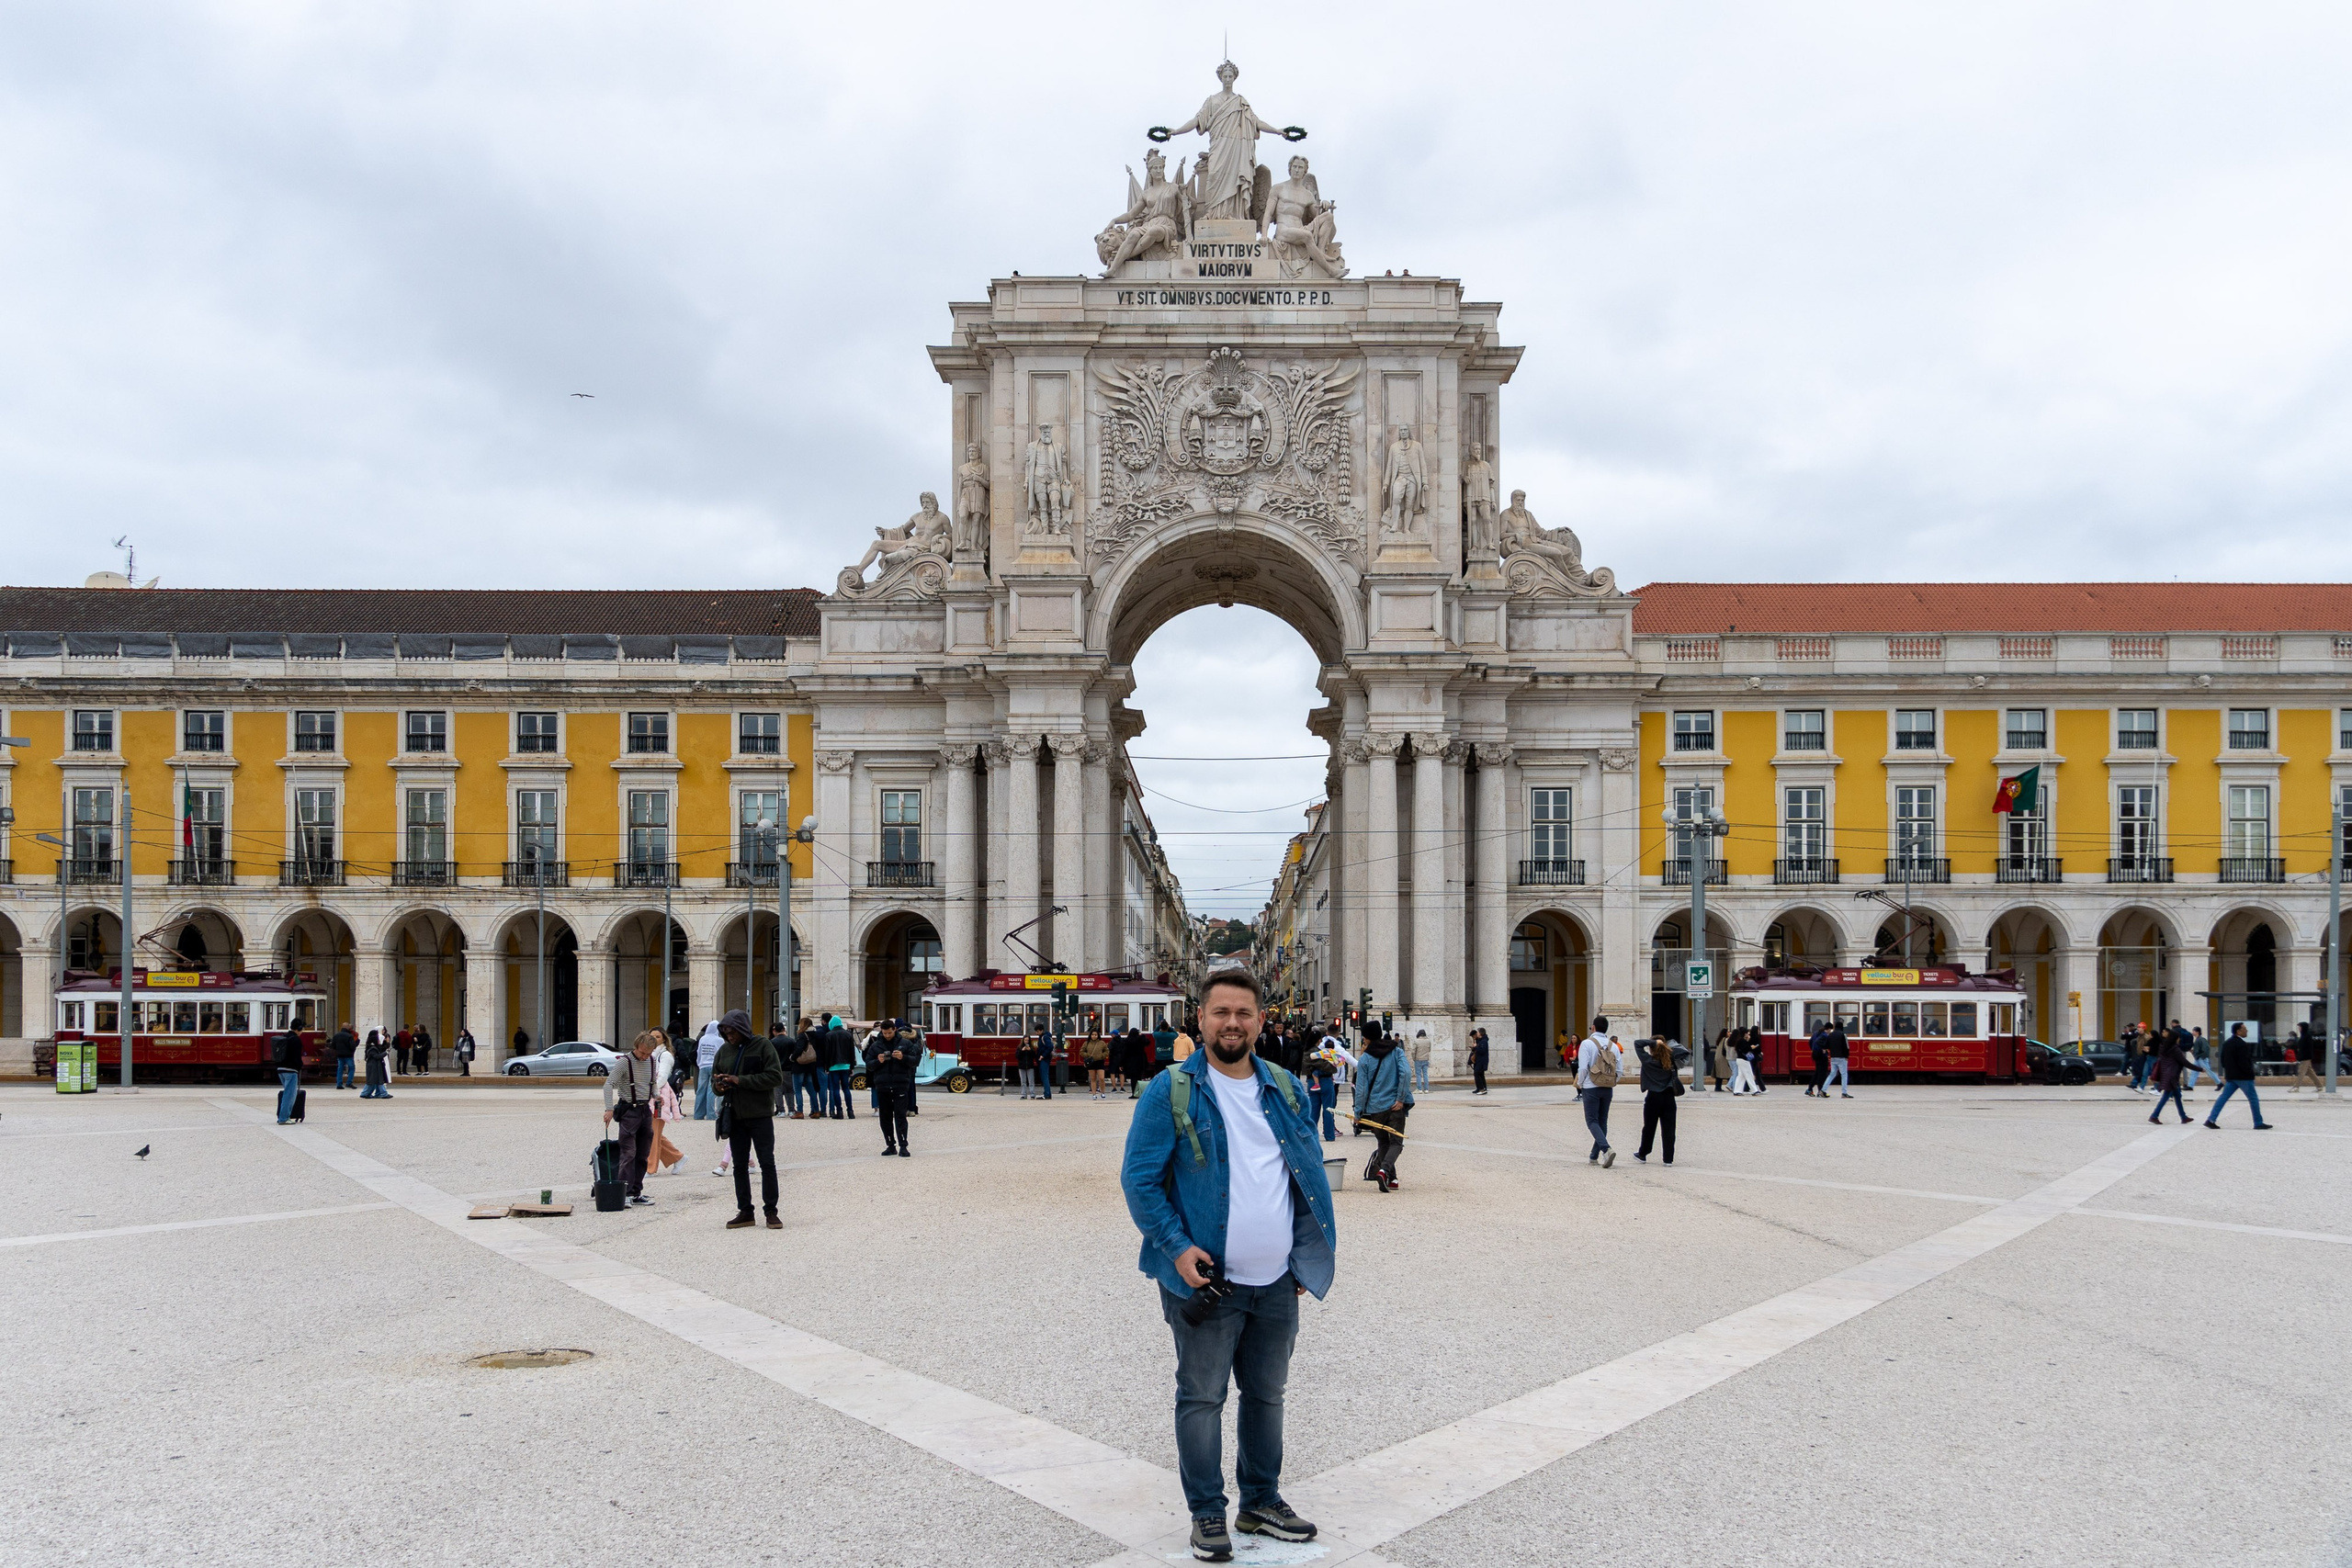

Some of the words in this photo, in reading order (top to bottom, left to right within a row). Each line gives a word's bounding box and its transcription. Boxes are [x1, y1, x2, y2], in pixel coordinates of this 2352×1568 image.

[1190, 244, 1261, 257] VIRTVTIBVS
[1199, 264, 1252, 276] MAIORVM
[1117, 291, 1134, 305] VT.
[1137, 291, 1158, 305] SIT.
